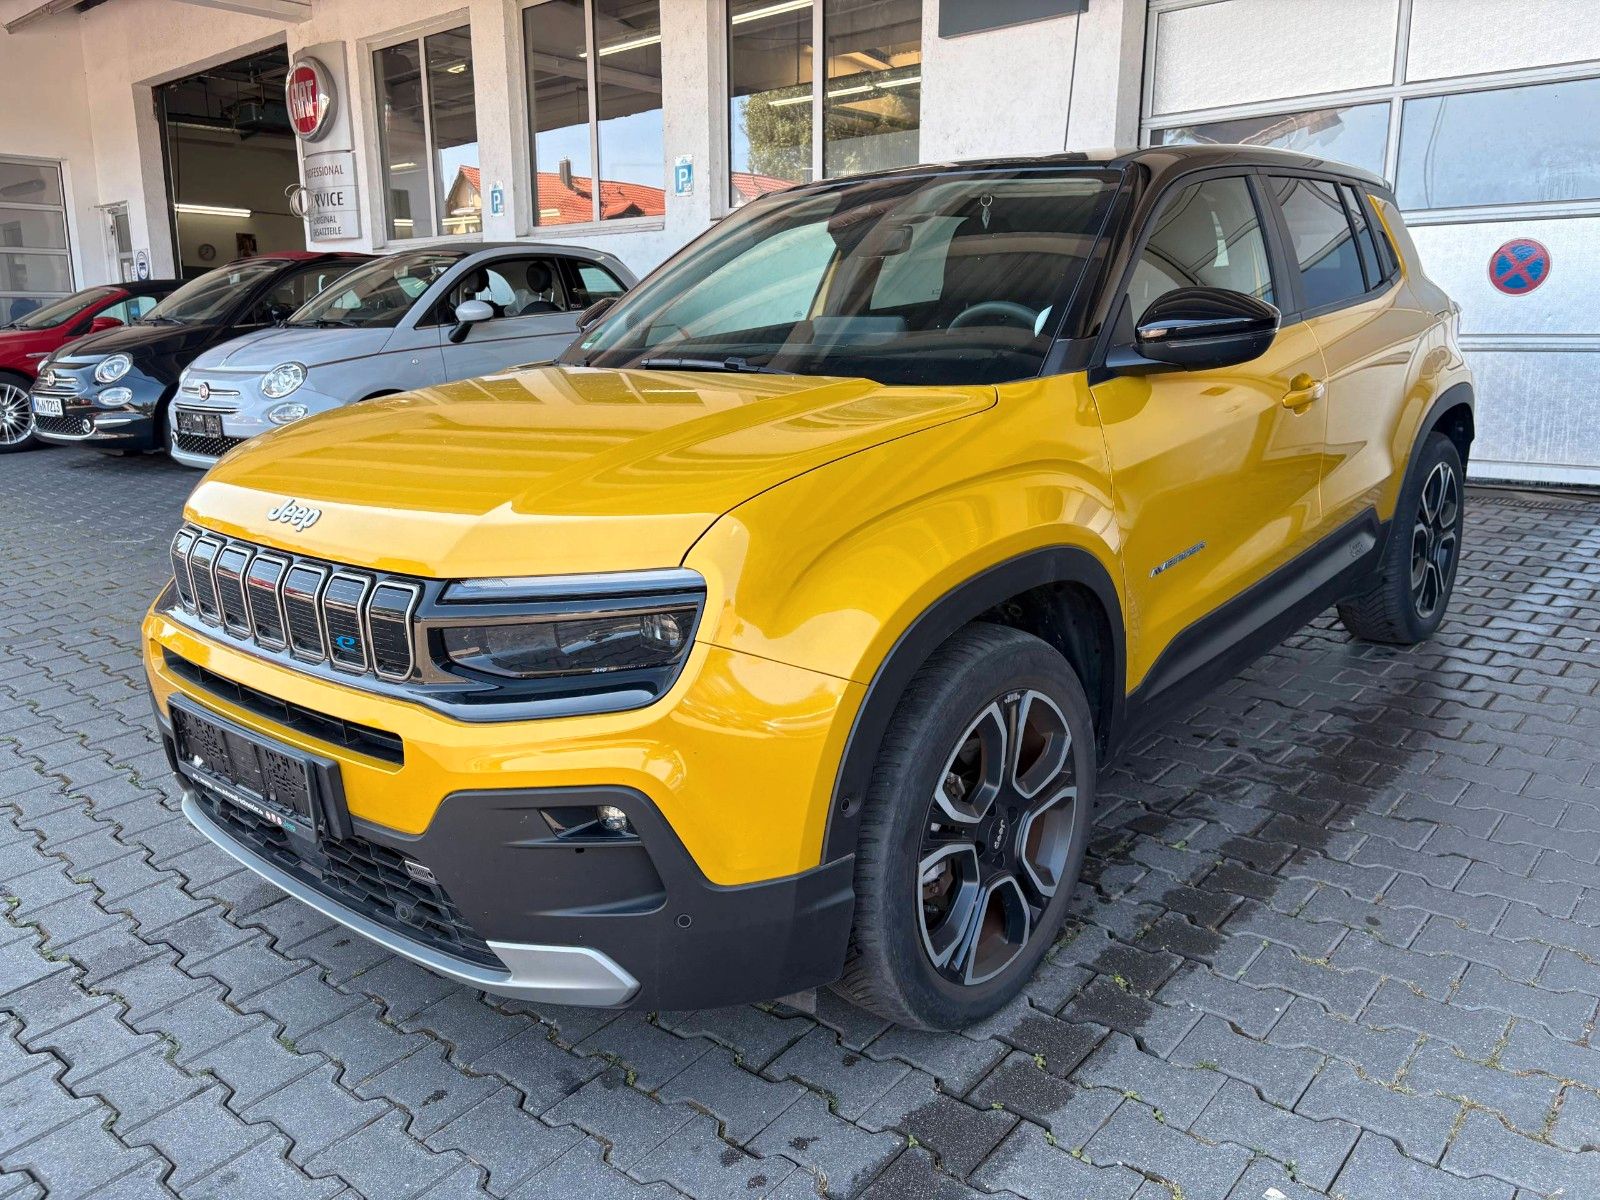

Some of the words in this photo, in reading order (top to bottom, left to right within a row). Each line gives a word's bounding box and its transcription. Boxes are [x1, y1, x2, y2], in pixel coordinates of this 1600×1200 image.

[679, 168, 689, 191] P
[312, 191, 345, 208] RVICE
[493, 192, 501, 212] P
[267, 498, 322, 532] Jeep
[993, 819, 1006, 850] Jeep
